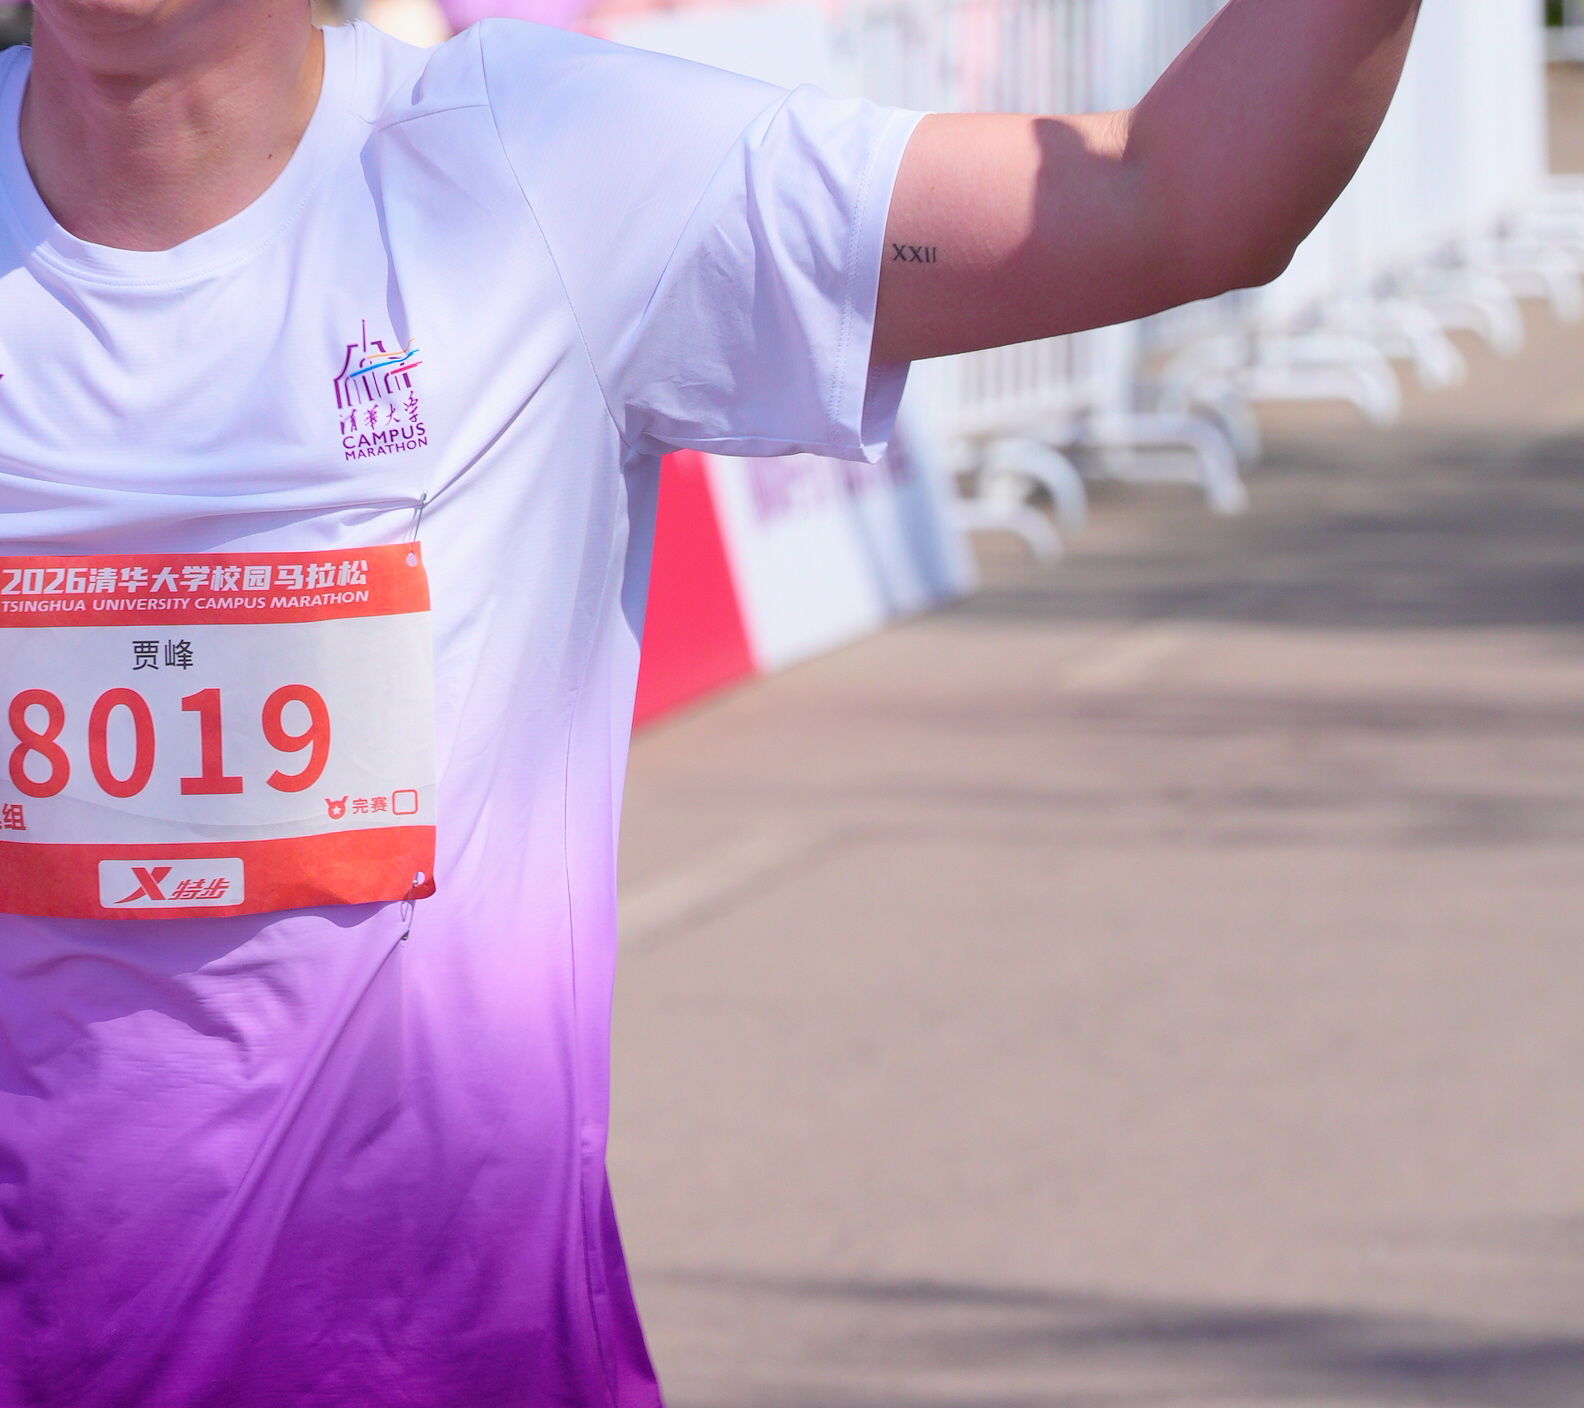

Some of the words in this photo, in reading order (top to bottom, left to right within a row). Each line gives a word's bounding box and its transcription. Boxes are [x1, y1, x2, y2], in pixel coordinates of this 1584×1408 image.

[891, 243, 937, 264] XXII
[342, 422, 426, 450] CAMPUS
[344, 436, 428, 461] MARATHON
[0, 560, 369, 595] 2026清华大学校园马拉松
[0, 599, 87, 613] TSINGHUA
[92, 597, 190, 612] UNIVERSITY
[194, 595, 267, 610] CAMPUS
[269, 590, 369, 609] MARATHON
[131, 639, 195, 671] 贾峰
[8, 683, 331, 798] 8019
[352, 796, 388, 814] 完赛
